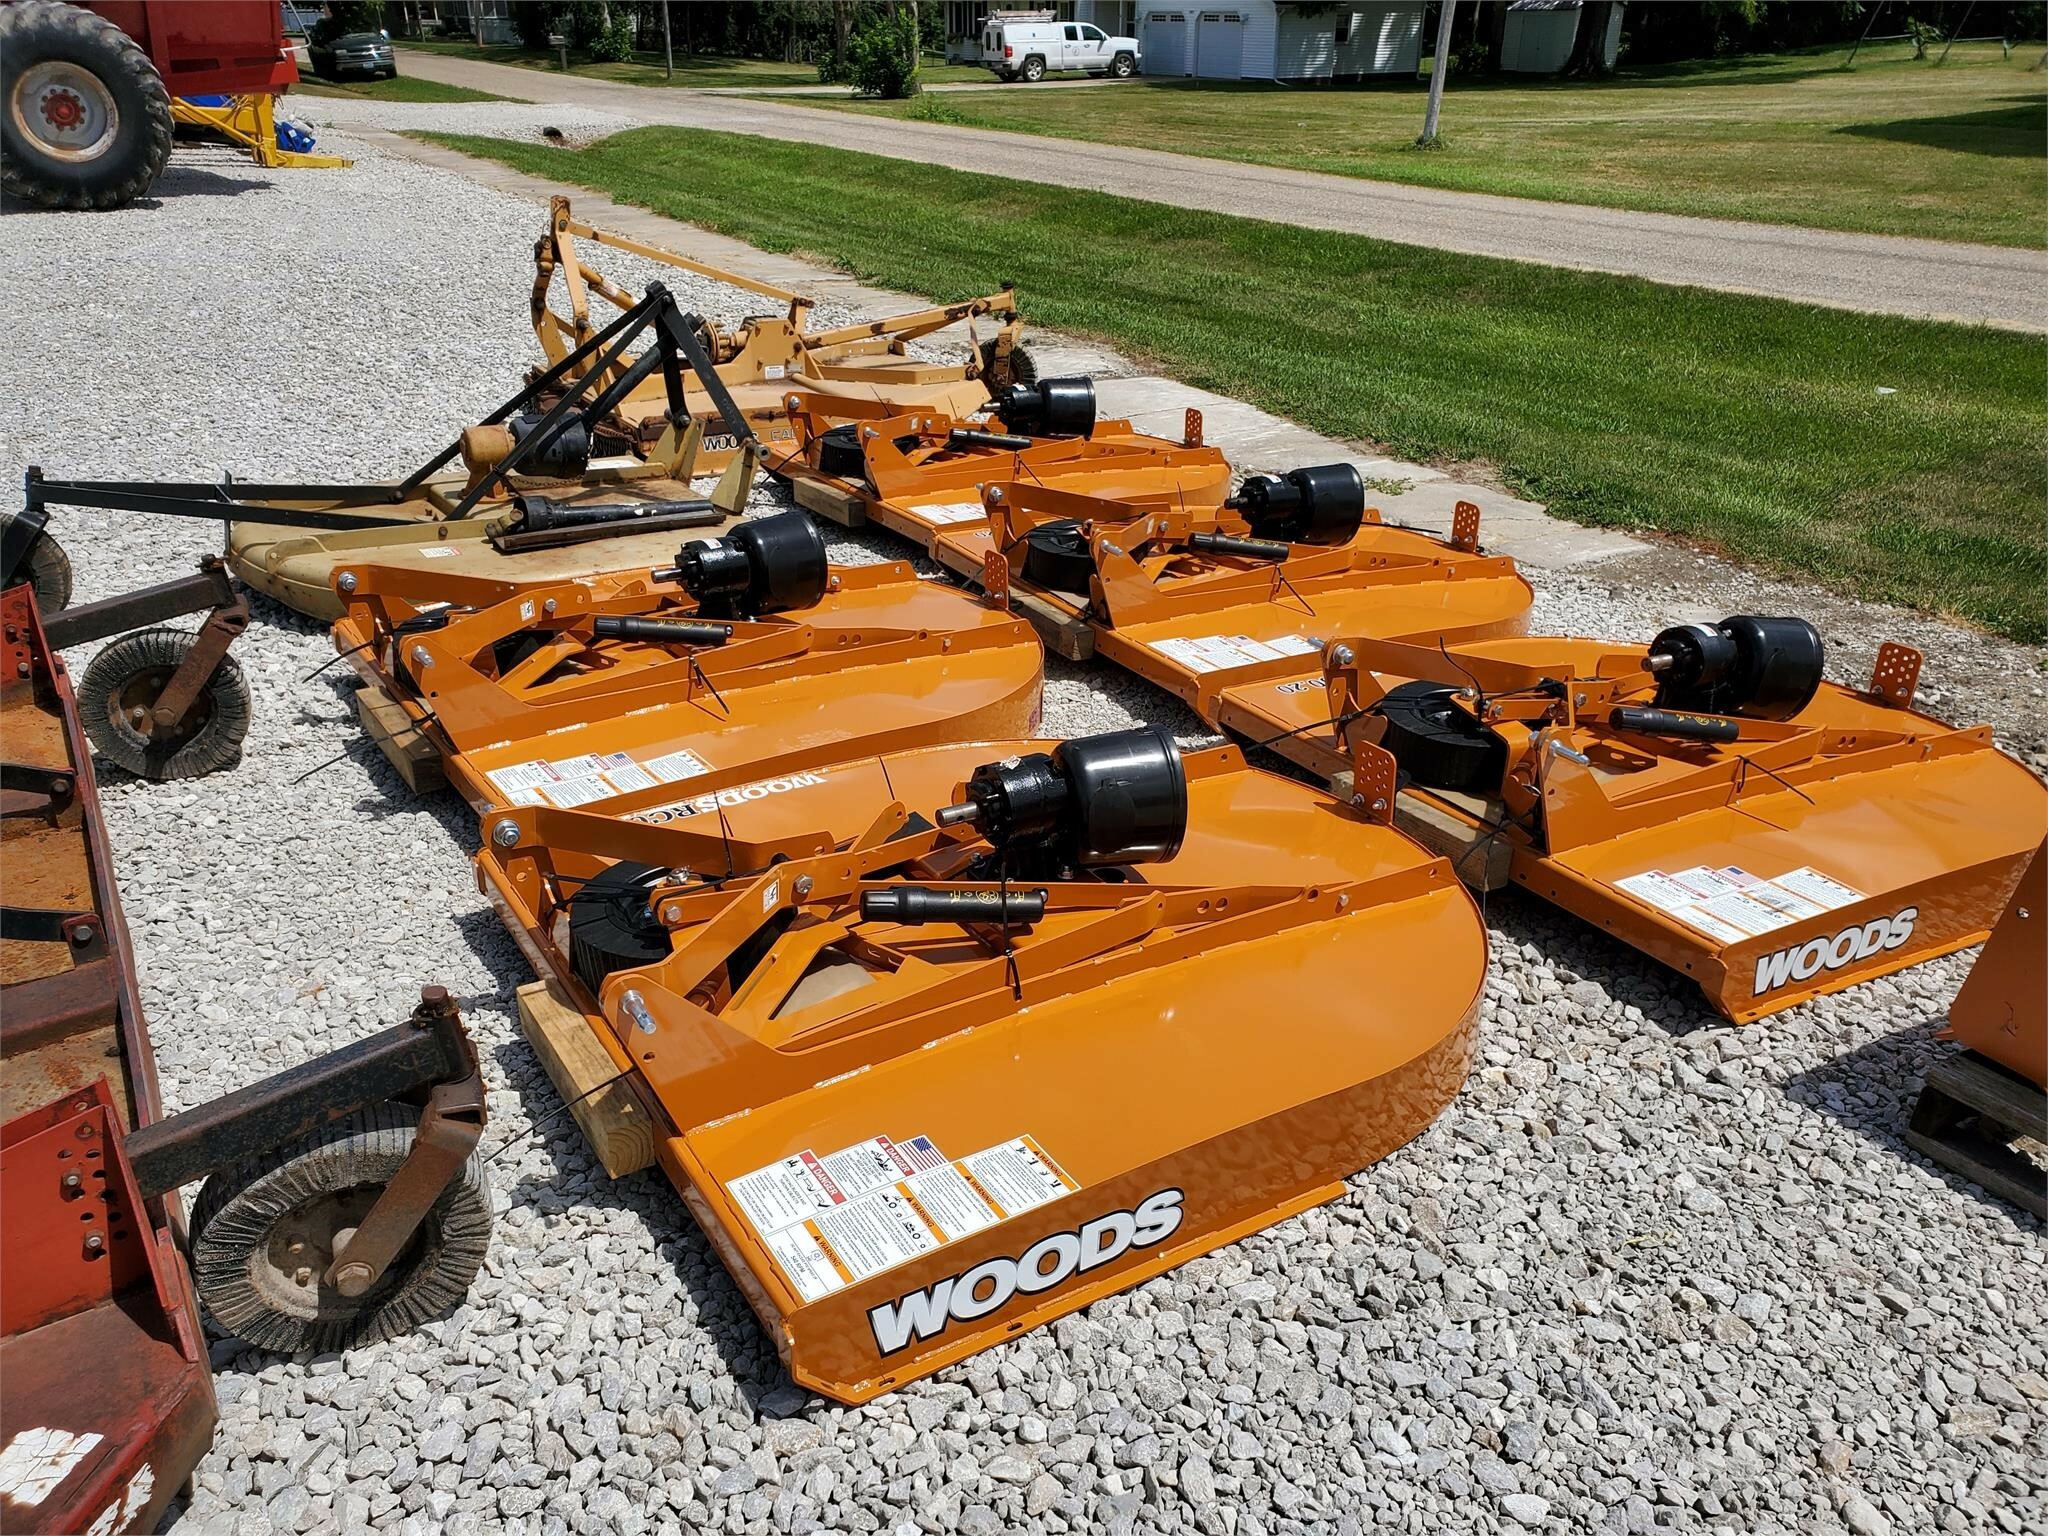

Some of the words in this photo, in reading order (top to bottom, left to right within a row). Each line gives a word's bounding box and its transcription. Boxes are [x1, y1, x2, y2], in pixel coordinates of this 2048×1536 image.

[703, 432, 758, 452] WOOS
[697, 773, 827, 814] WOODS
[1752, 905, 1919, 997] WOODS
[886, 1146, 910, 1173] DANGER
[1039, 1153, 1063, 1178] WARNING
[813, 1166, 839, 1195] DANGER
[970, 1179, 994, 1206] WARNING
[912, 1201, 935, 1229] WARNING
[819, 1241, 842, 1268] WARNING
[866, 1187, 1186, 1358] WOODS
